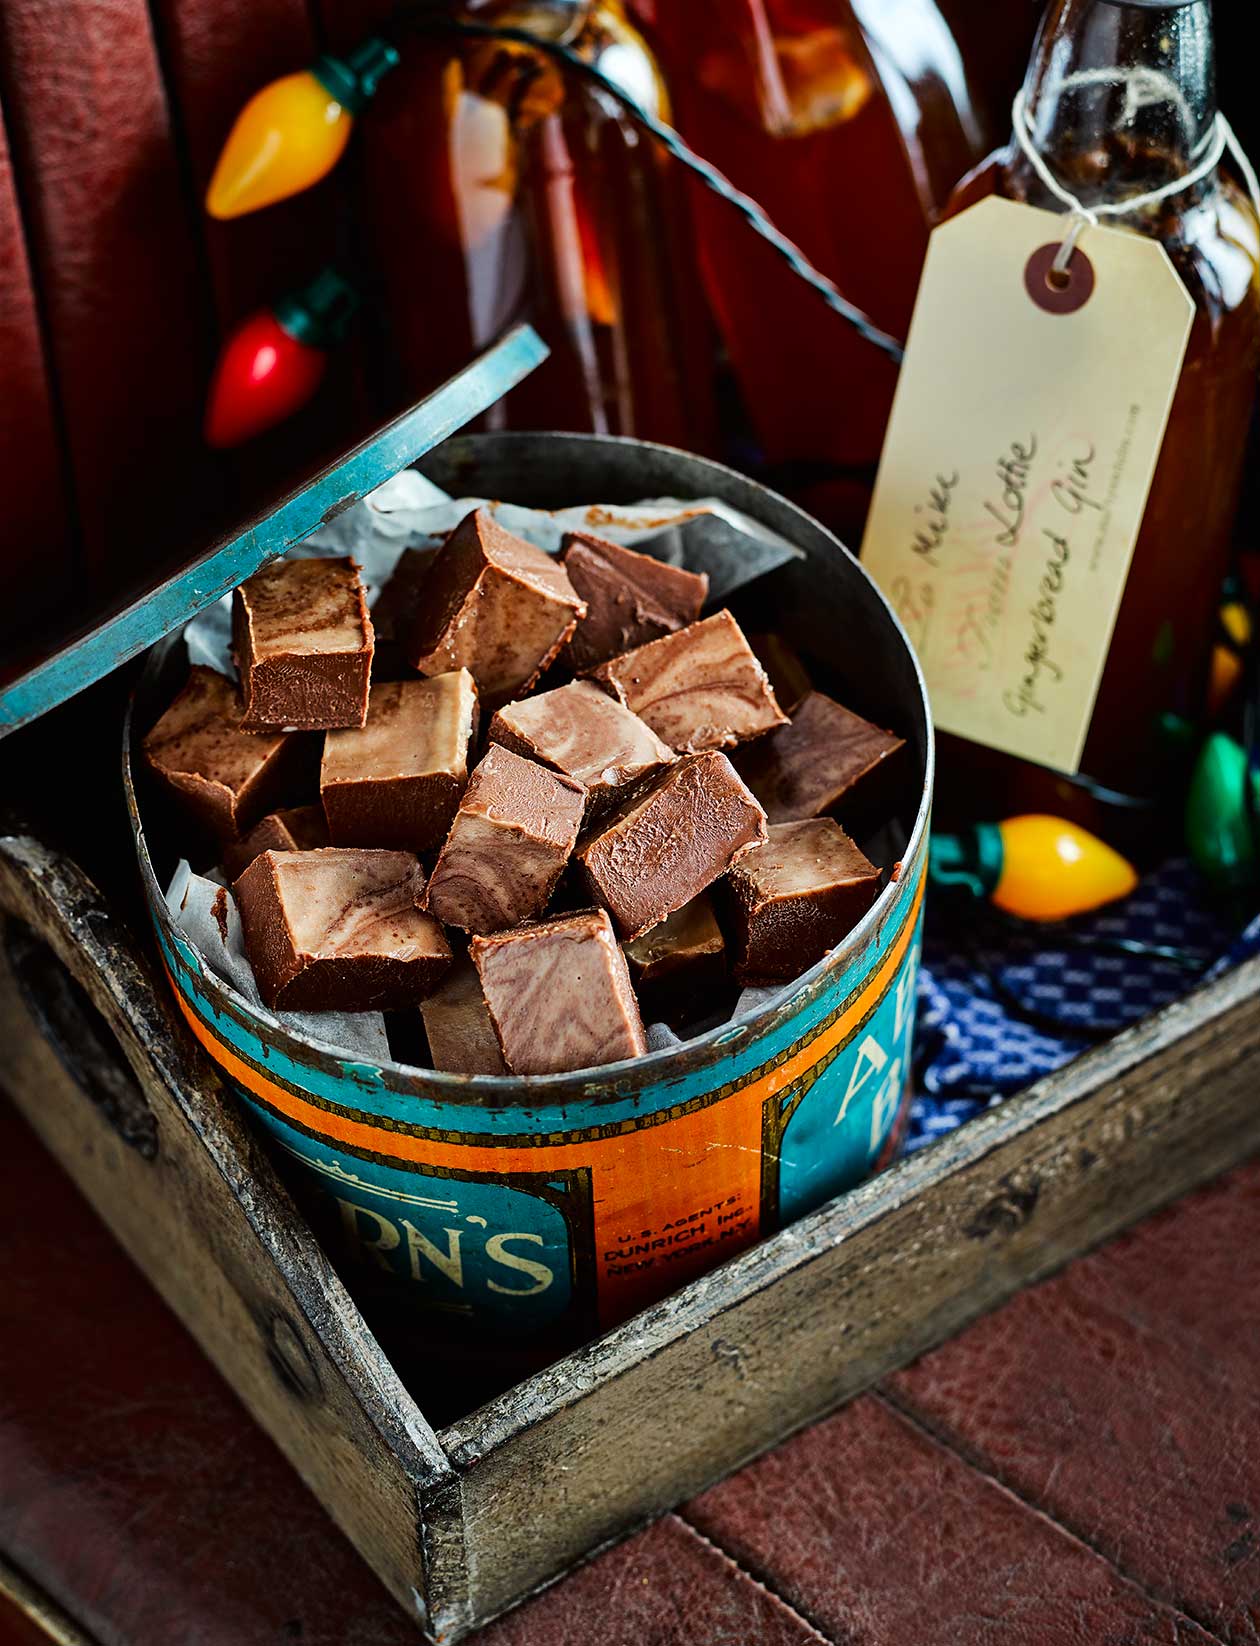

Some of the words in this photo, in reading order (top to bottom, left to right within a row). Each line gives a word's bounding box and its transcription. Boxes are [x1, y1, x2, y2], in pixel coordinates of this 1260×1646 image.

[1002, 529, 1070, 716] Gingerbread
[1051, 441, 1104, 514] Gin
[603, 1223, 705, 1262] DUNRICH
[606, 1257, 655, 1278] NEW
